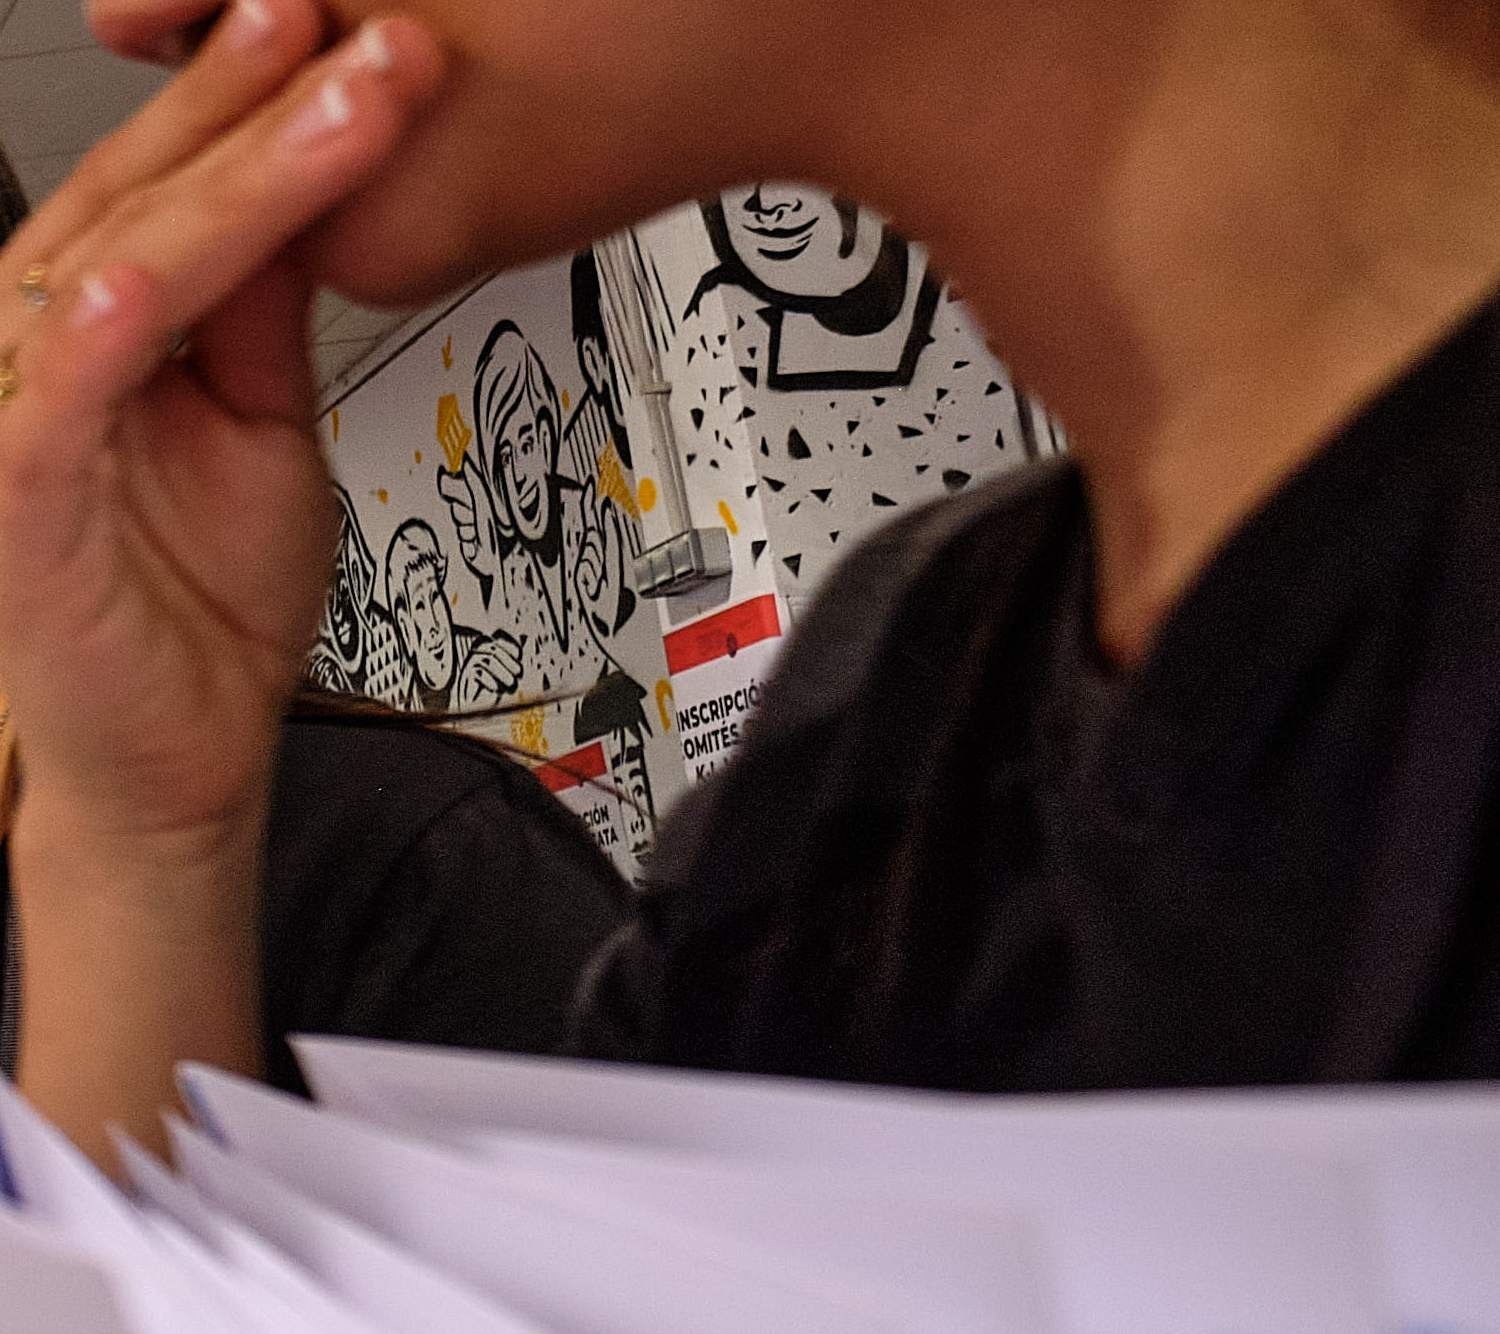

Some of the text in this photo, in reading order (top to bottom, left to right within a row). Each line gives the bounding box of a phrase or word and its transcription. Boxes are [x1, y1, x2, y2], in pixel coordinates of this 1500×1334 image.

[682, 720, 739, 760] OMITÉS
[583, 802, 609, 827] CIÓN
[592, 827, 619, 847] ATA
